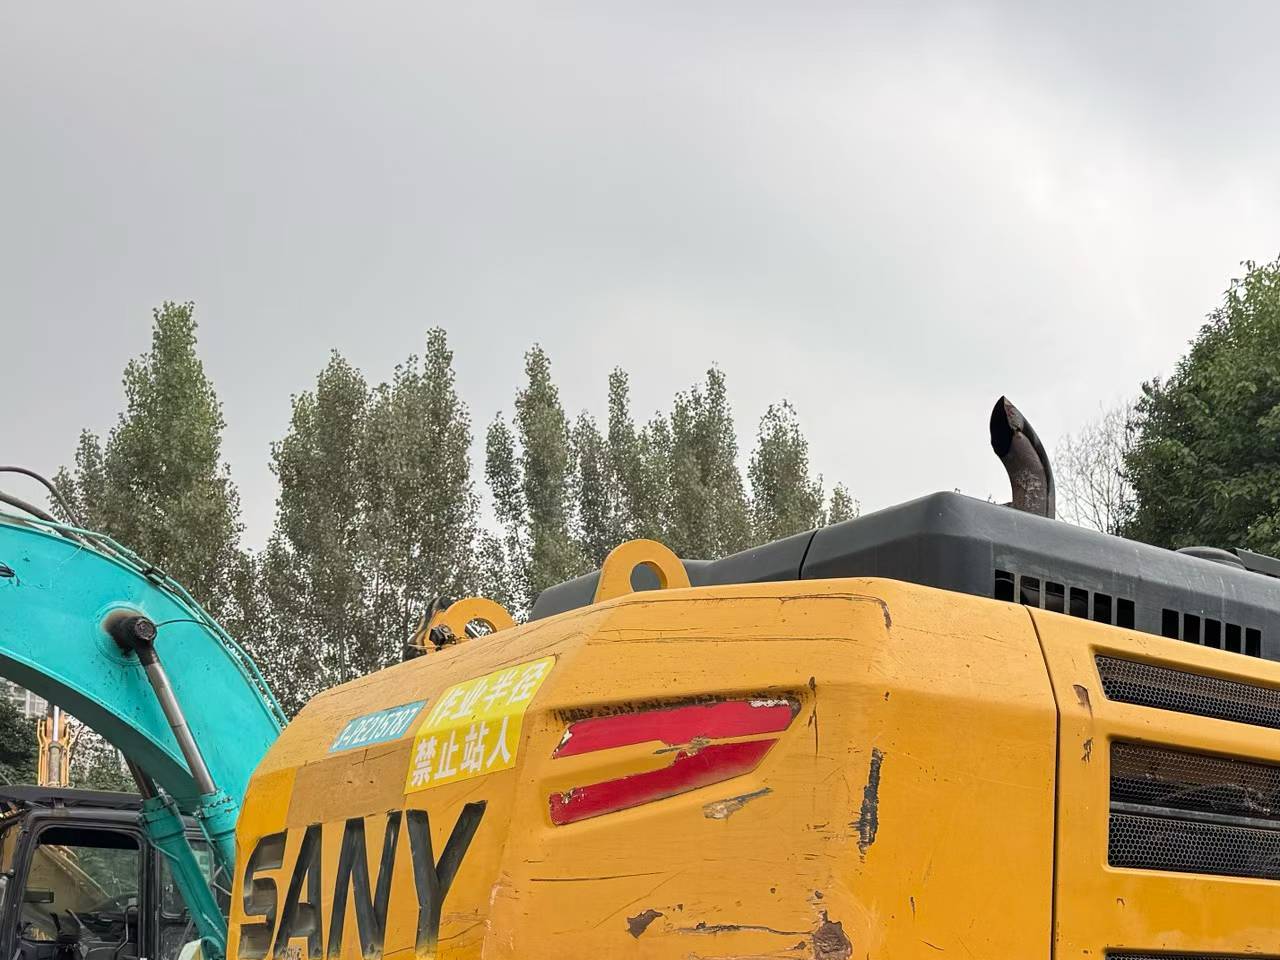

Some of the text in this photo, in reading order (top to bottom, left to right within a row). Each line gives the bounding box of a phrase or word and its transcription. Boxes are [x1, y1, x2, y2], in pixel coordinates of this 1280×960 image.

[426, 661, 548, 728] 作业半径
[411, 715, 511, 786] 禁止站人
[238, 800, 487, 960] SANY
